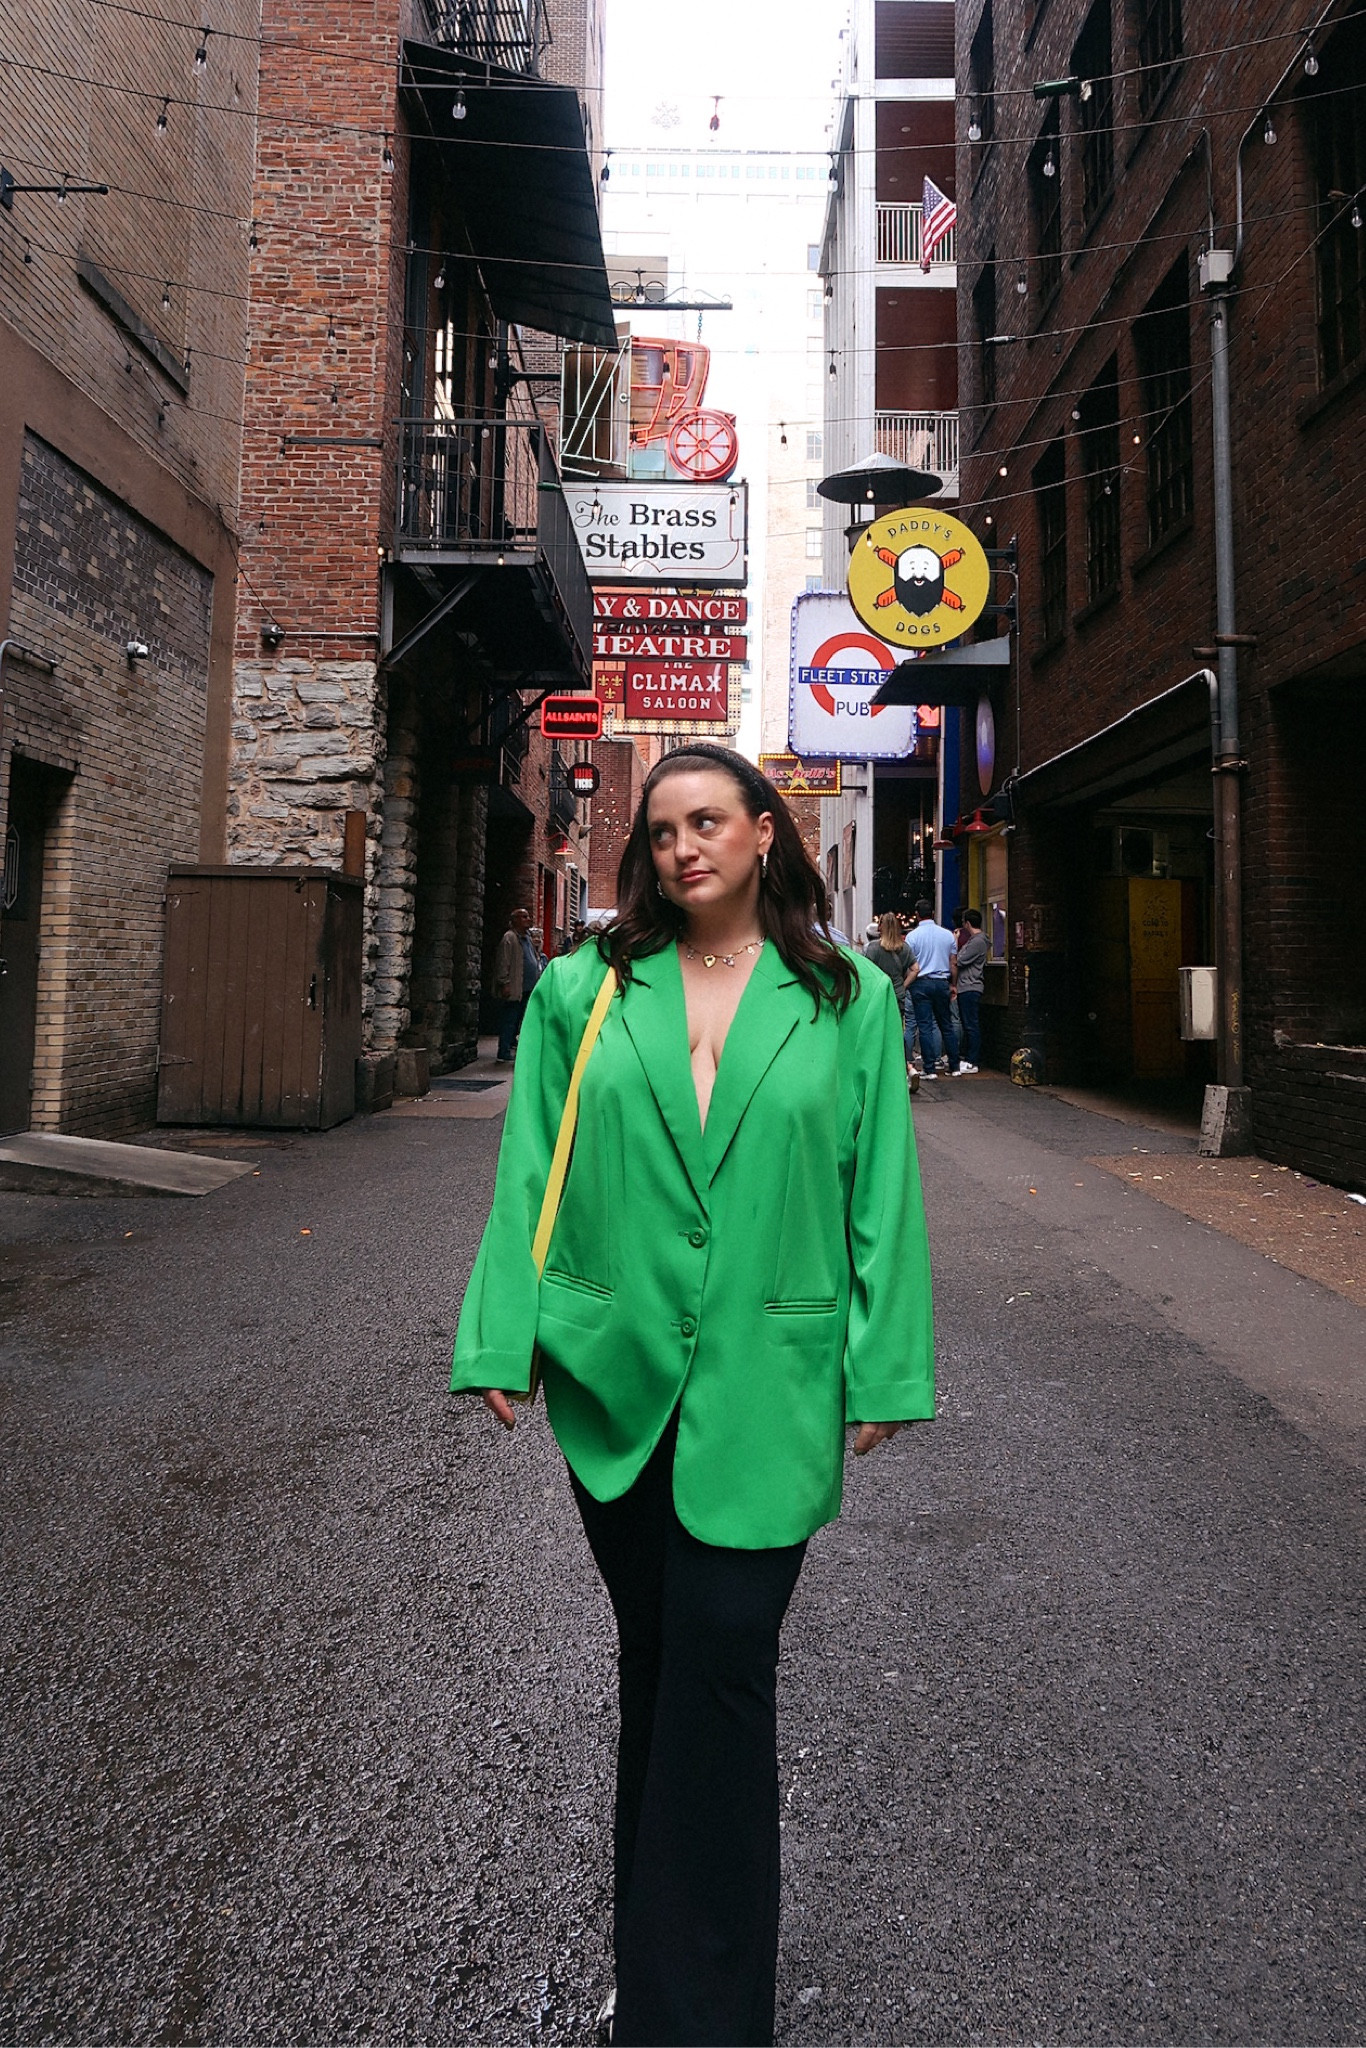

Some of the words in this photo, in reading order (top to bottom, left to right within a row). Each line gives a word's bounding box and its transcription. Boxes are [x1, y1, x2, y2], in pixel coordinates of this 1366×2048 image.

[574, 500, 620, 528] The
[629, 503, 717, 527] Brass
[887, 520, 953, 539] DADDY'S
[585, 532, 706, 560] Stables
[622, 599, 642, 617] &
[648, 599, 740, 620] DANCE
[896, 621, 941, 635] DOGS
[632, 674, 722, 692] CLIMAX
[801, 669, 845, 683] FLEET
[643, 697, 711, 710] SALOON
[836, 701, 870, 716] PUB
[545, 712, 598, 723] ALLSAINTS
